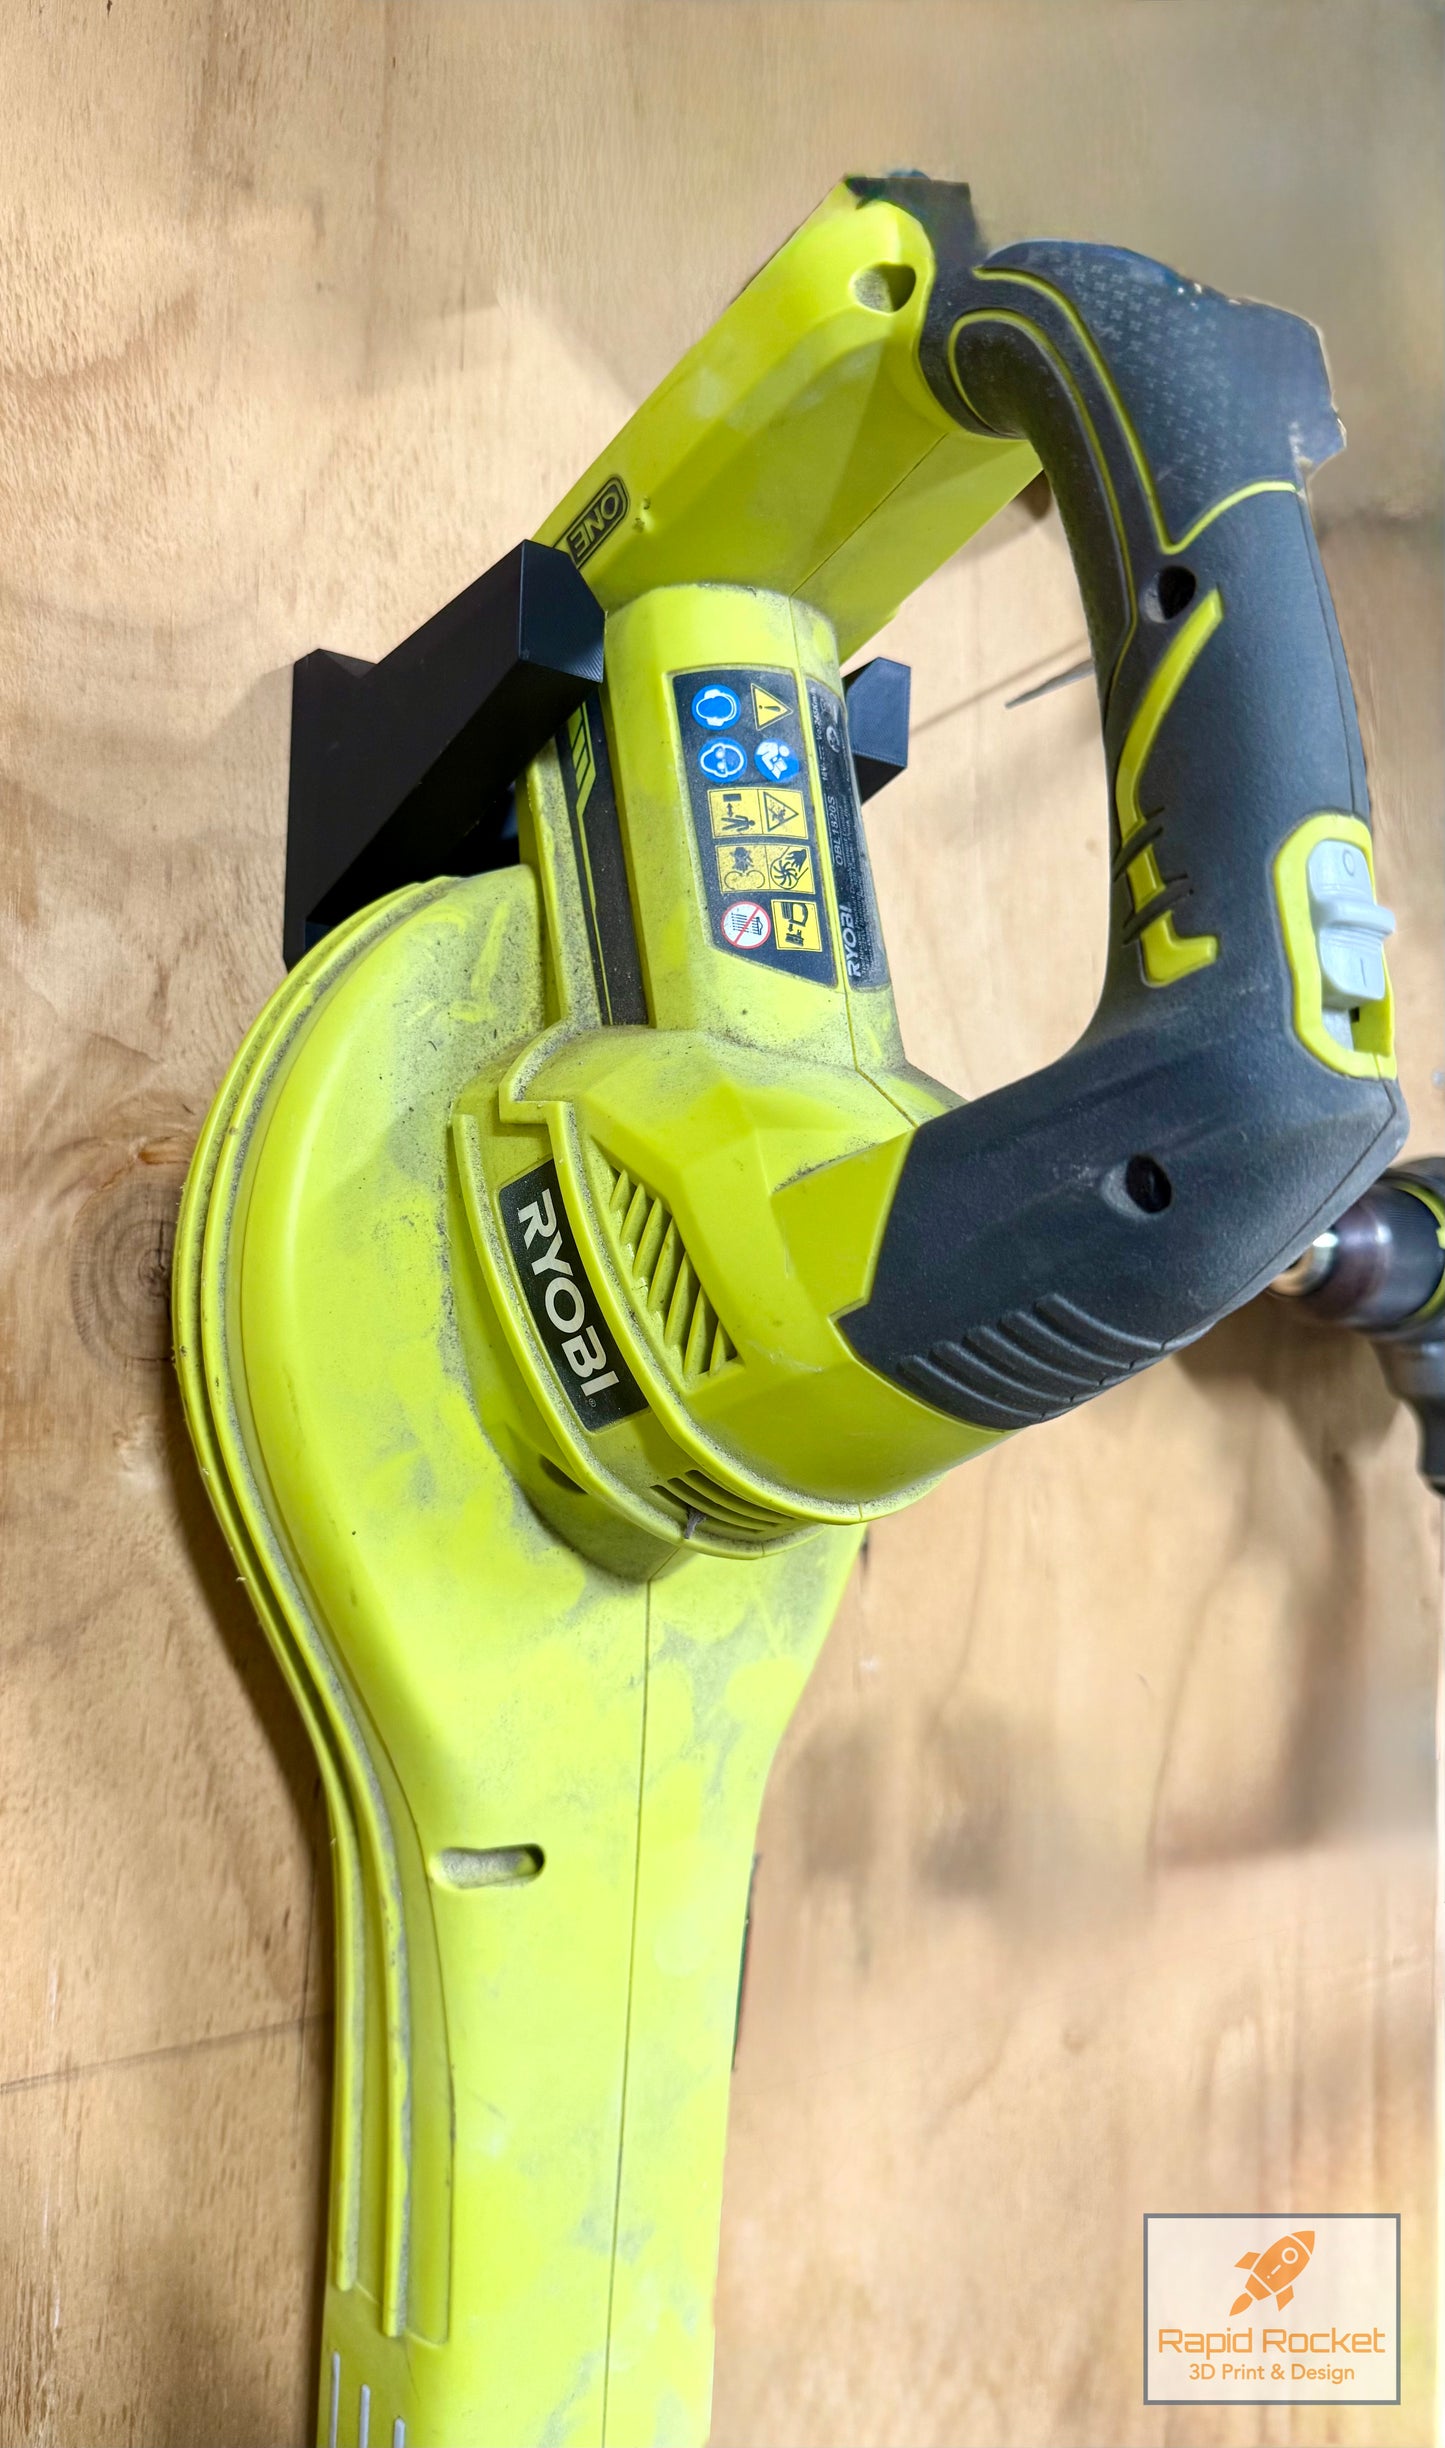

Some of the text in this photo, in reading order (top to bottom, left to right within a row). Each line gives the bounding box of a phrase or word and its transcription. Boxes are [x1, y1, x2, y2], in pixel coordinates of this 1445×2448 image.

[569, 492, 620, 558] ONE
[827, 795, 844, 866] OBL1820S
[840, 904, 862, 977] RYOBI
[517, 1188, 620, 1397] RYOBI
